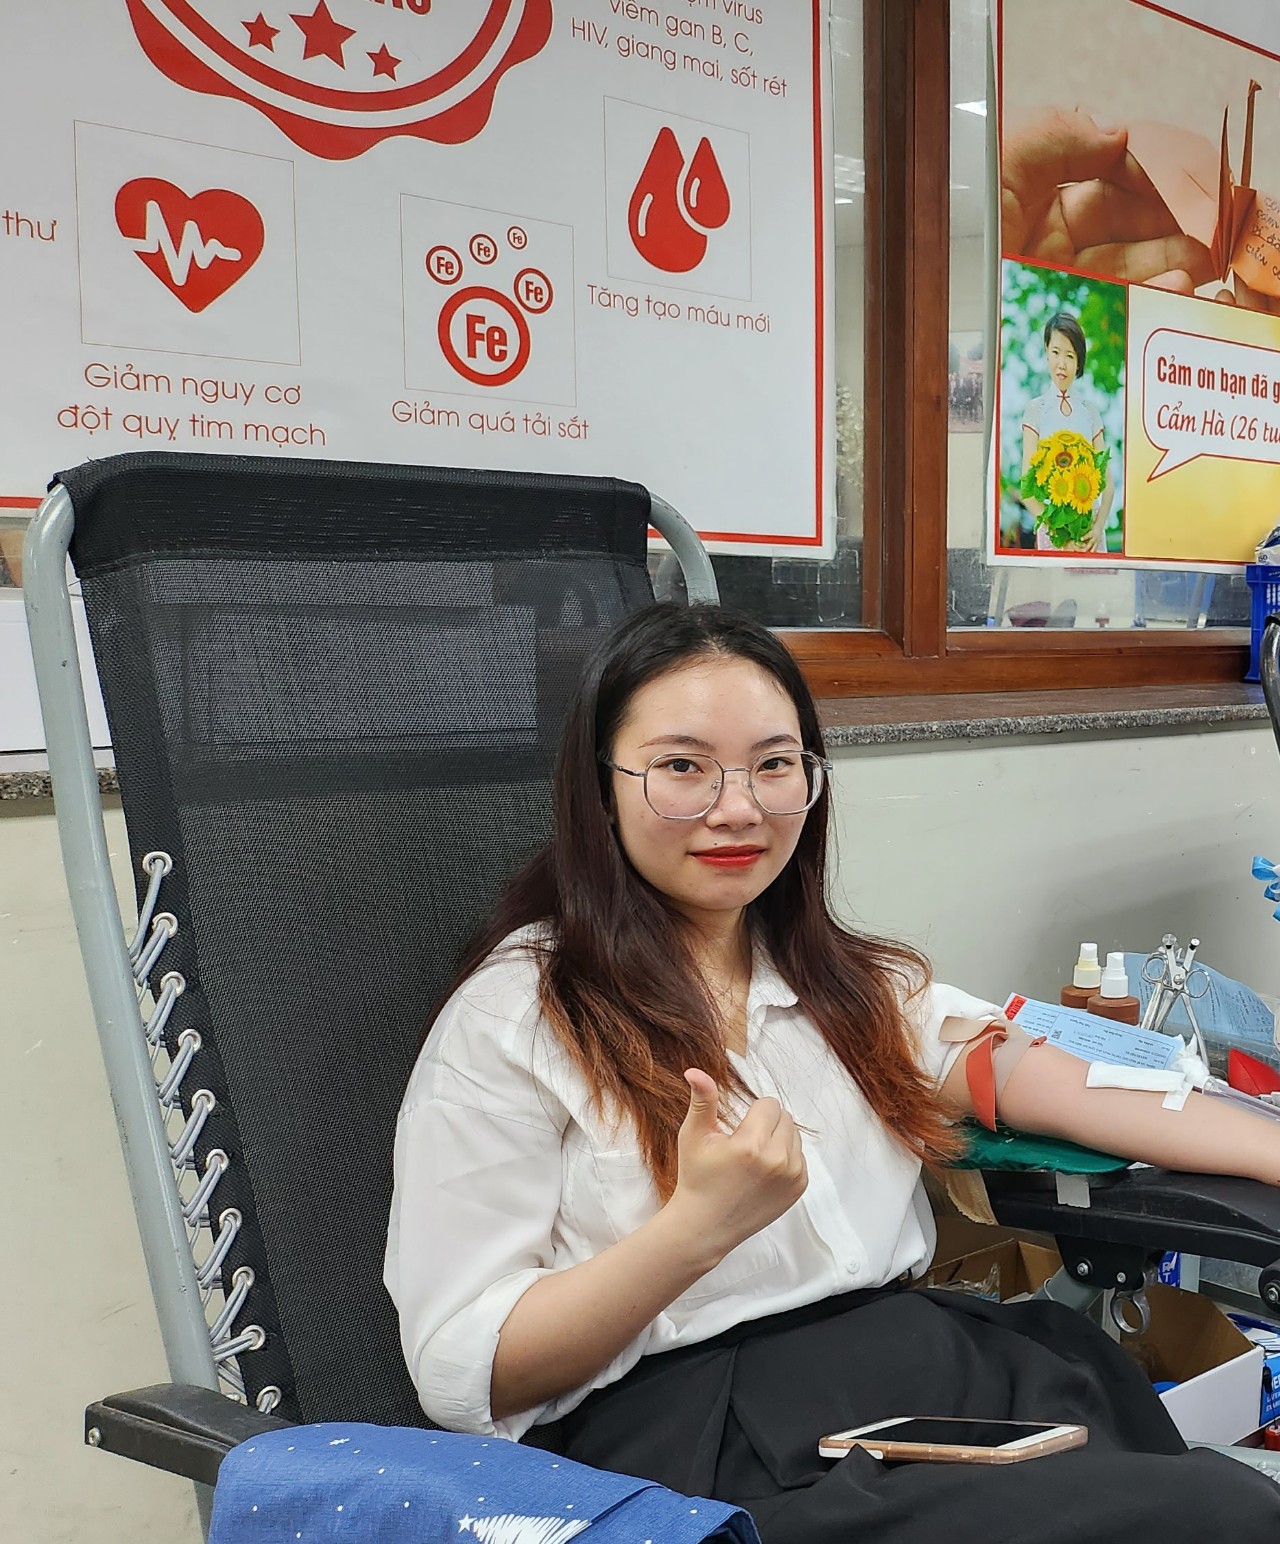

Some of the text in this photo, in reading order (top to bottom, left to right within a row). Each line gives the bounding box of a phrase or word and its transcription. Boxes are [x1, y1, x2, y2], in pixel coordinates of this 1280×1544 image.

[723, 0, 763, 25] virus
[665, 16, 705, 41] gan
[711, 25, 727, 48] B,
[734, 33, 754, 56] C,
[571, 17, 788, 98] HIV, giang mai, sốt rét
[2, 210, 57, 241] thư
[512, 232, 523, 244] Fe
[436, 256, 454, 276] Fe
[477, 242, 491, 258] Fe
[525, 280, 544, 303] Fe
[587, 284, 770, 333] Tăng tạo máu mới
[466, 313, 508, 363] Fe
[84, 363, 301, 406] Giảm nguy cơ
[1157, 354, 1192, 387] Cảm
[1197, 366, 1215, 391] ơn
[1220, 367, 1247, 400] bạn
[1251, 373, 1268, 400] đã
[57, 404, 326, 448] đột quỵ tim mạch
[391, 400, 589, 440] Giảm quá tải sắt
[1157, 400, 1197, 433] Cẩm
[1201, 409, 1225, 437] Hà
[1231, 414, 1259, 441] (26
